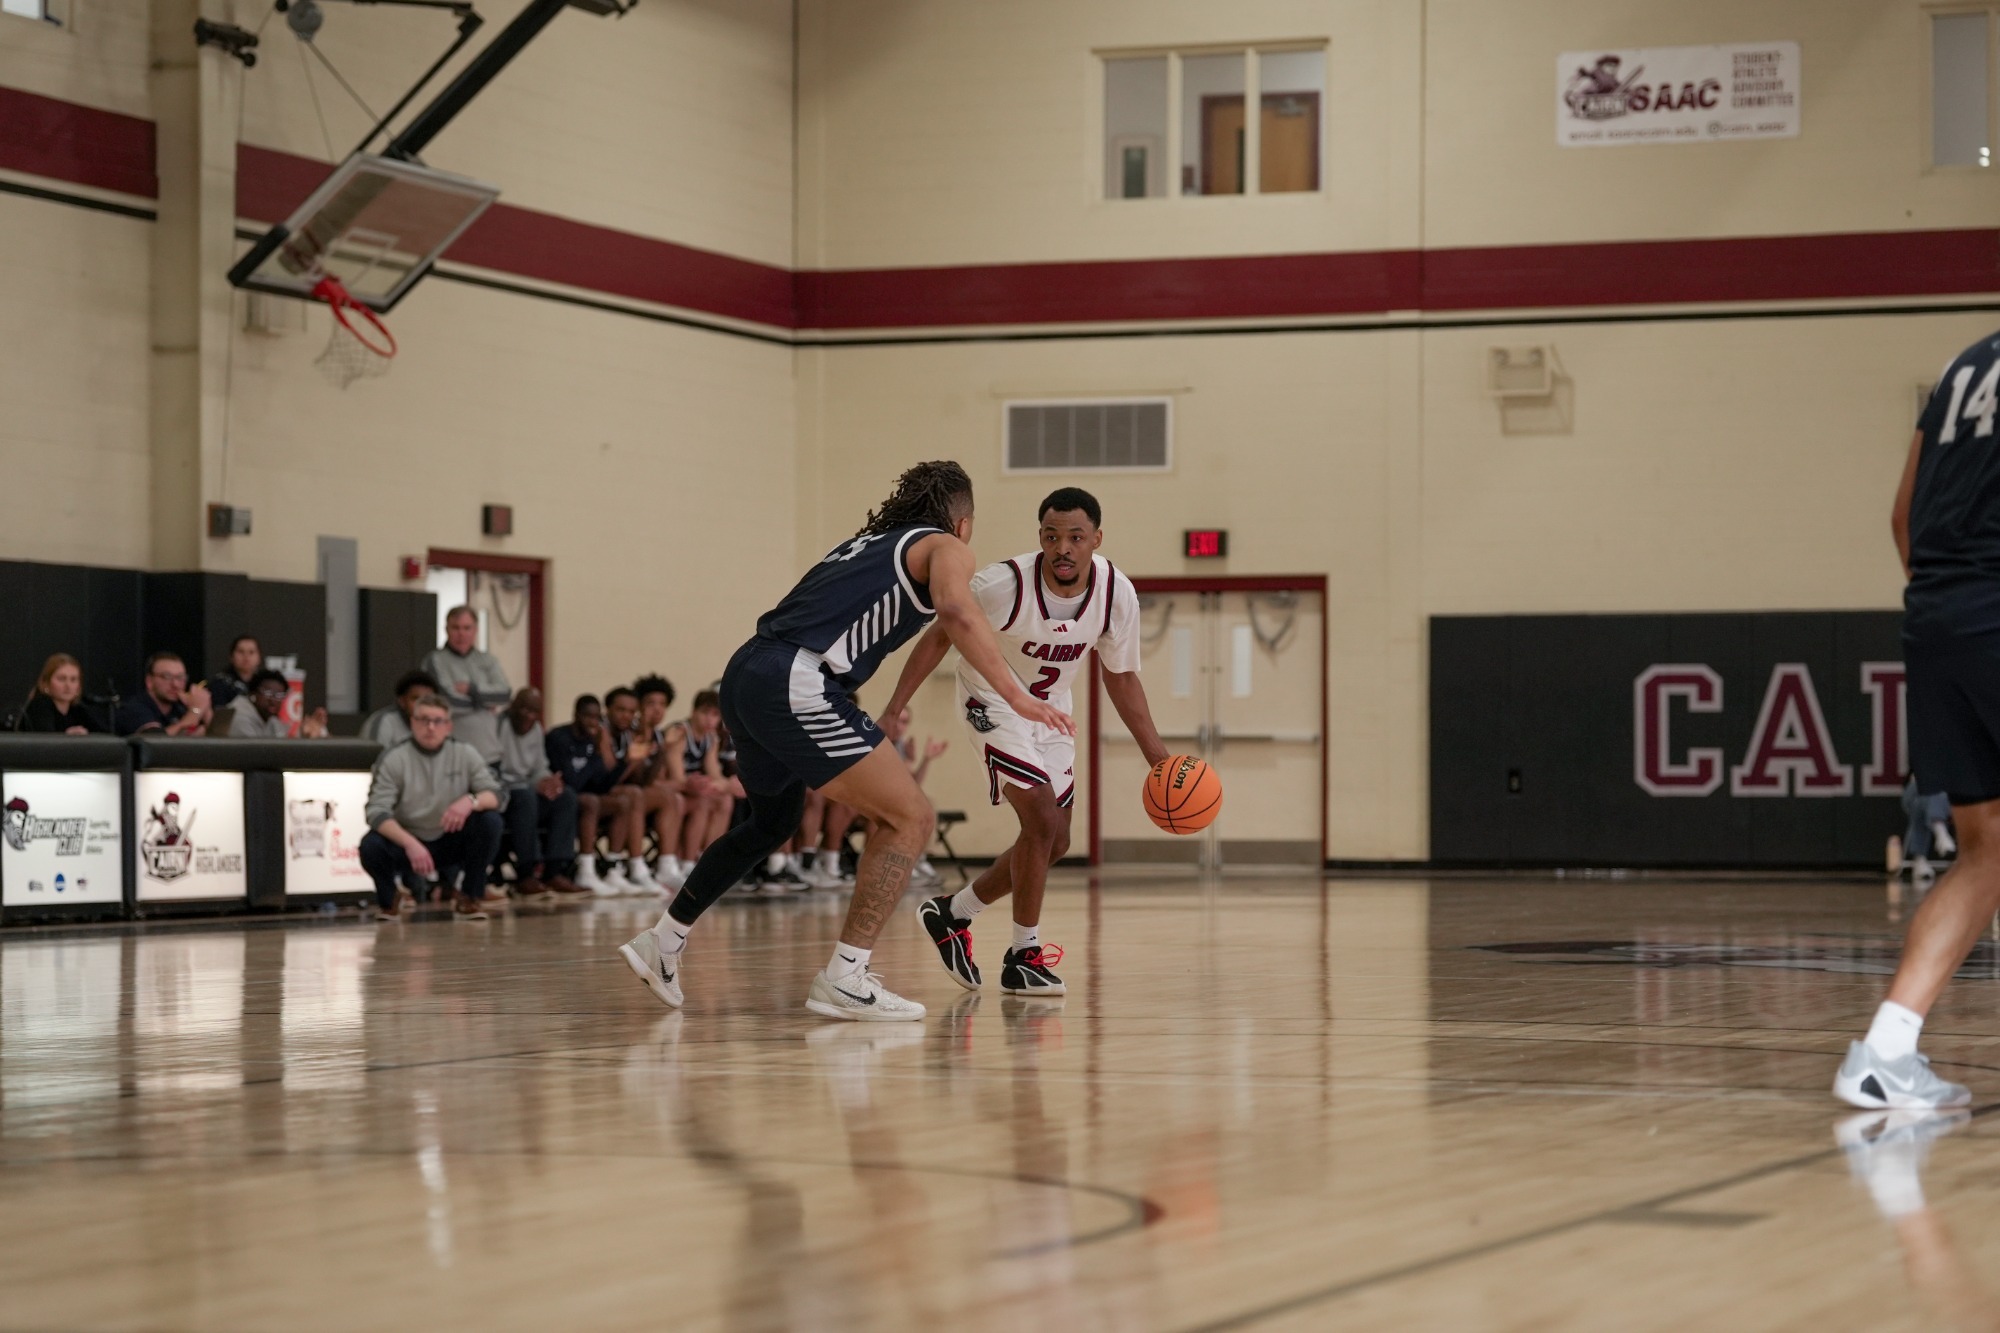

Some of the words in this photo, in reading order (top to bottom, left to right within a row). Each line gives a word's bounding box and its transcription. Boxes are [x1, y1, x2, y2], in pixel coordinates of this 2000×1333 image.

[1628, 78, 1722, 112] SAAC
[1939, 358, 2000, 445] 14
[1021, 641, 1088, 662] CAIRN
[1029, 665, 1061, 701] 2
[1173, 755, 1201, 789] Wilson
